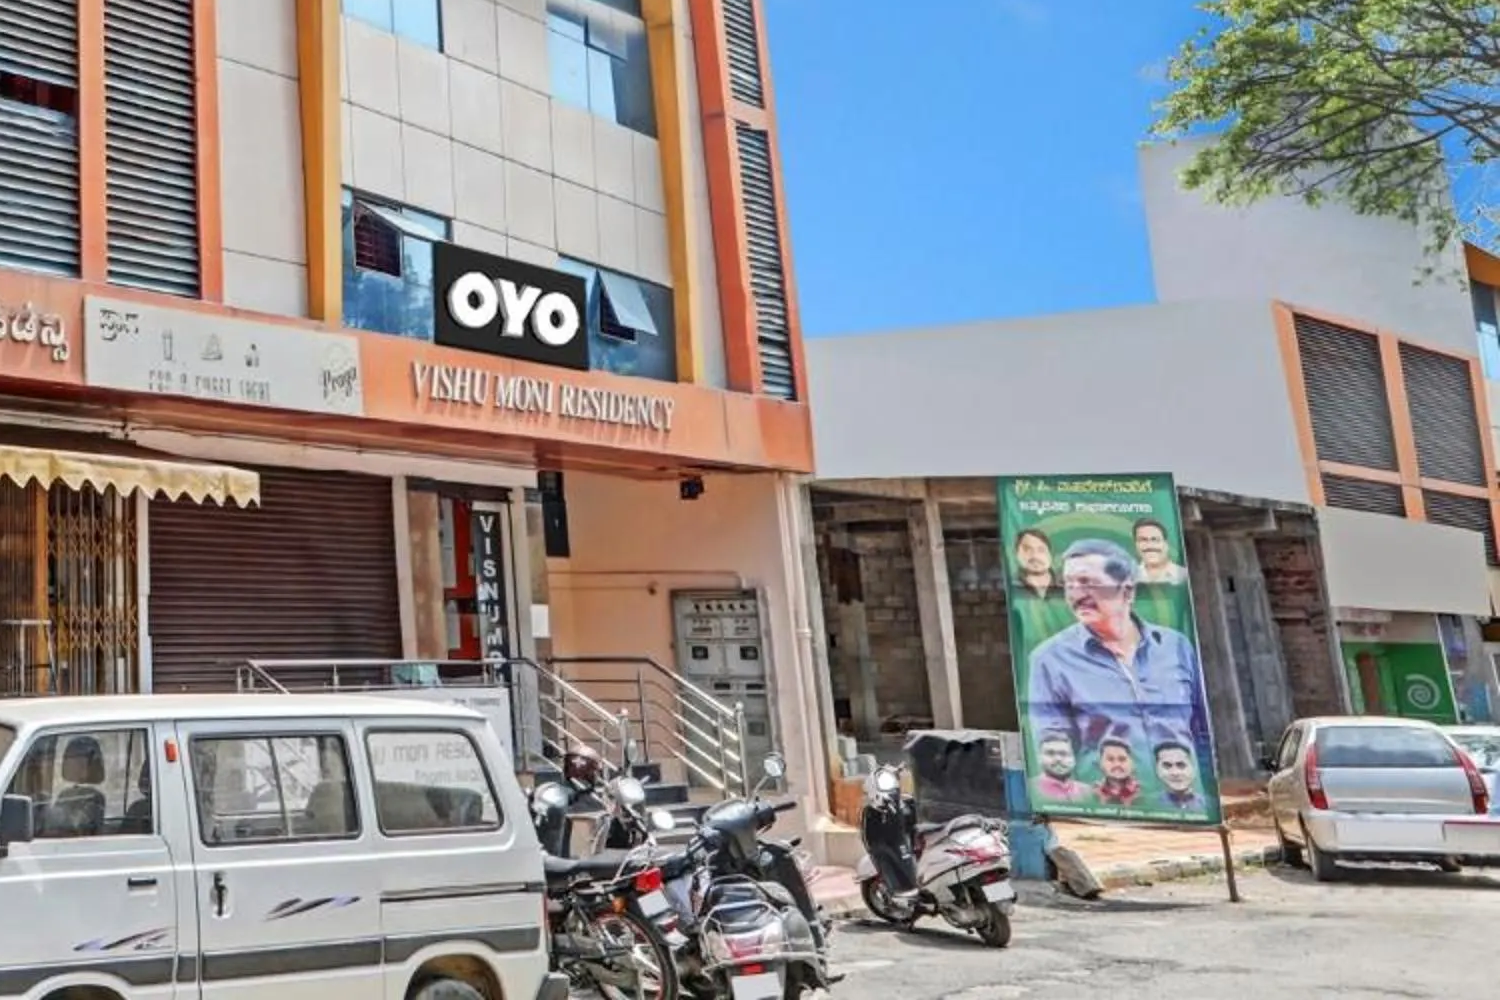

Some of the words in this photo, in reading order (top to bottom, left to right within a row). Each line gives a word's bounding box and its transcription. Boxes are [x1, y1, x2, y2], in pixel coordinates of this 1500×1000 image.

[448, 271, 579, 346] OYO
[412, 361, 490, 407] VISHU
[495, 374, 553, 414] MONI
[559, 384, 675, 431] RESIDENCY
